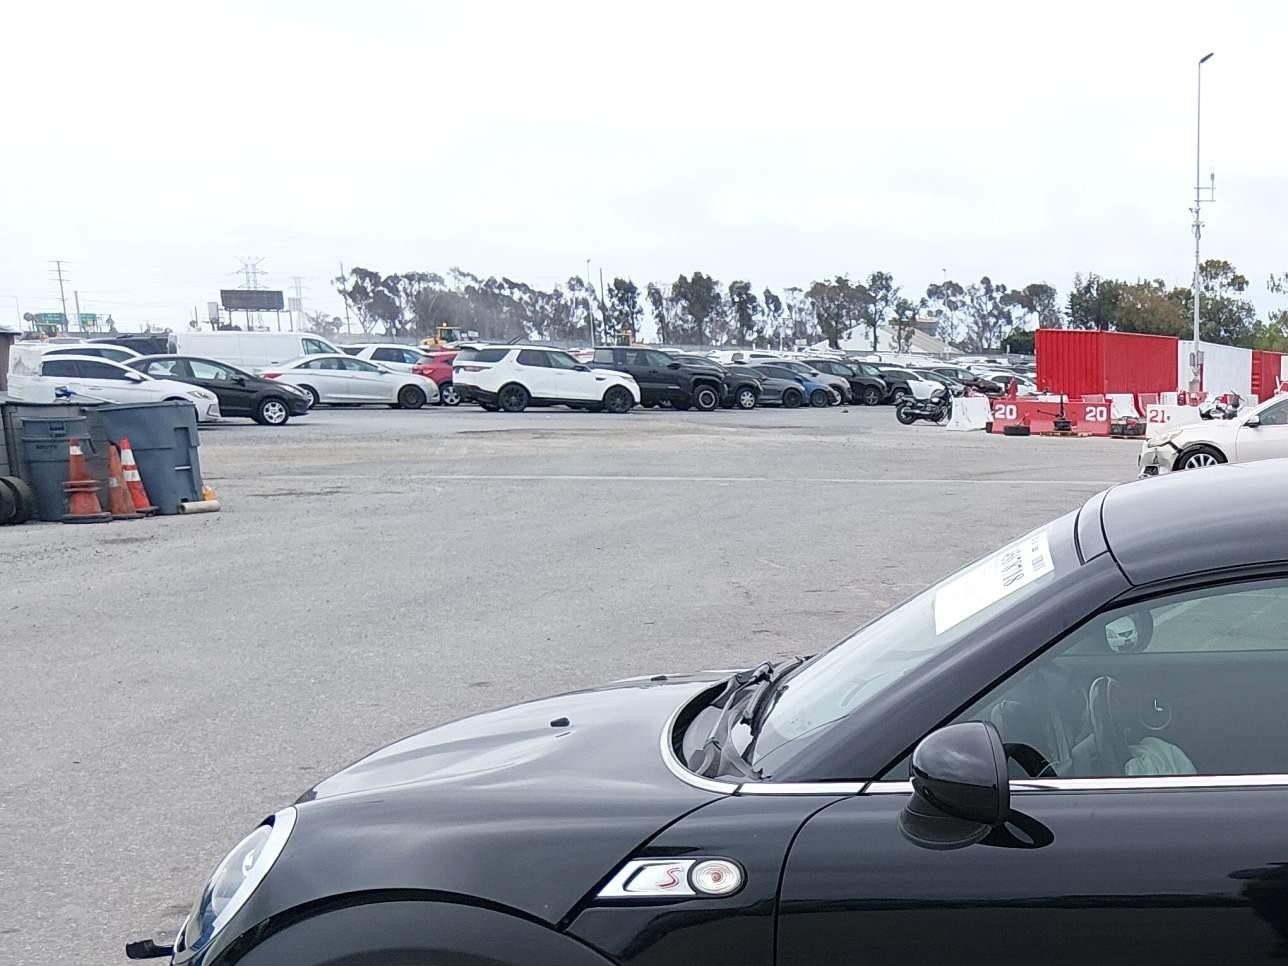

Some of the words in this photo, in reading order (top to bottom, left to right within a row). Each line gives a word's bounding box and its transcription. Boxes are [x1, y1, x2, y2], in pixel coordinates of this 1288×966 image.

[995, 405, 1017, 419] 20
[1085, 406, 1108, 421] 20
[1149, 409, 1166, 423] 21
